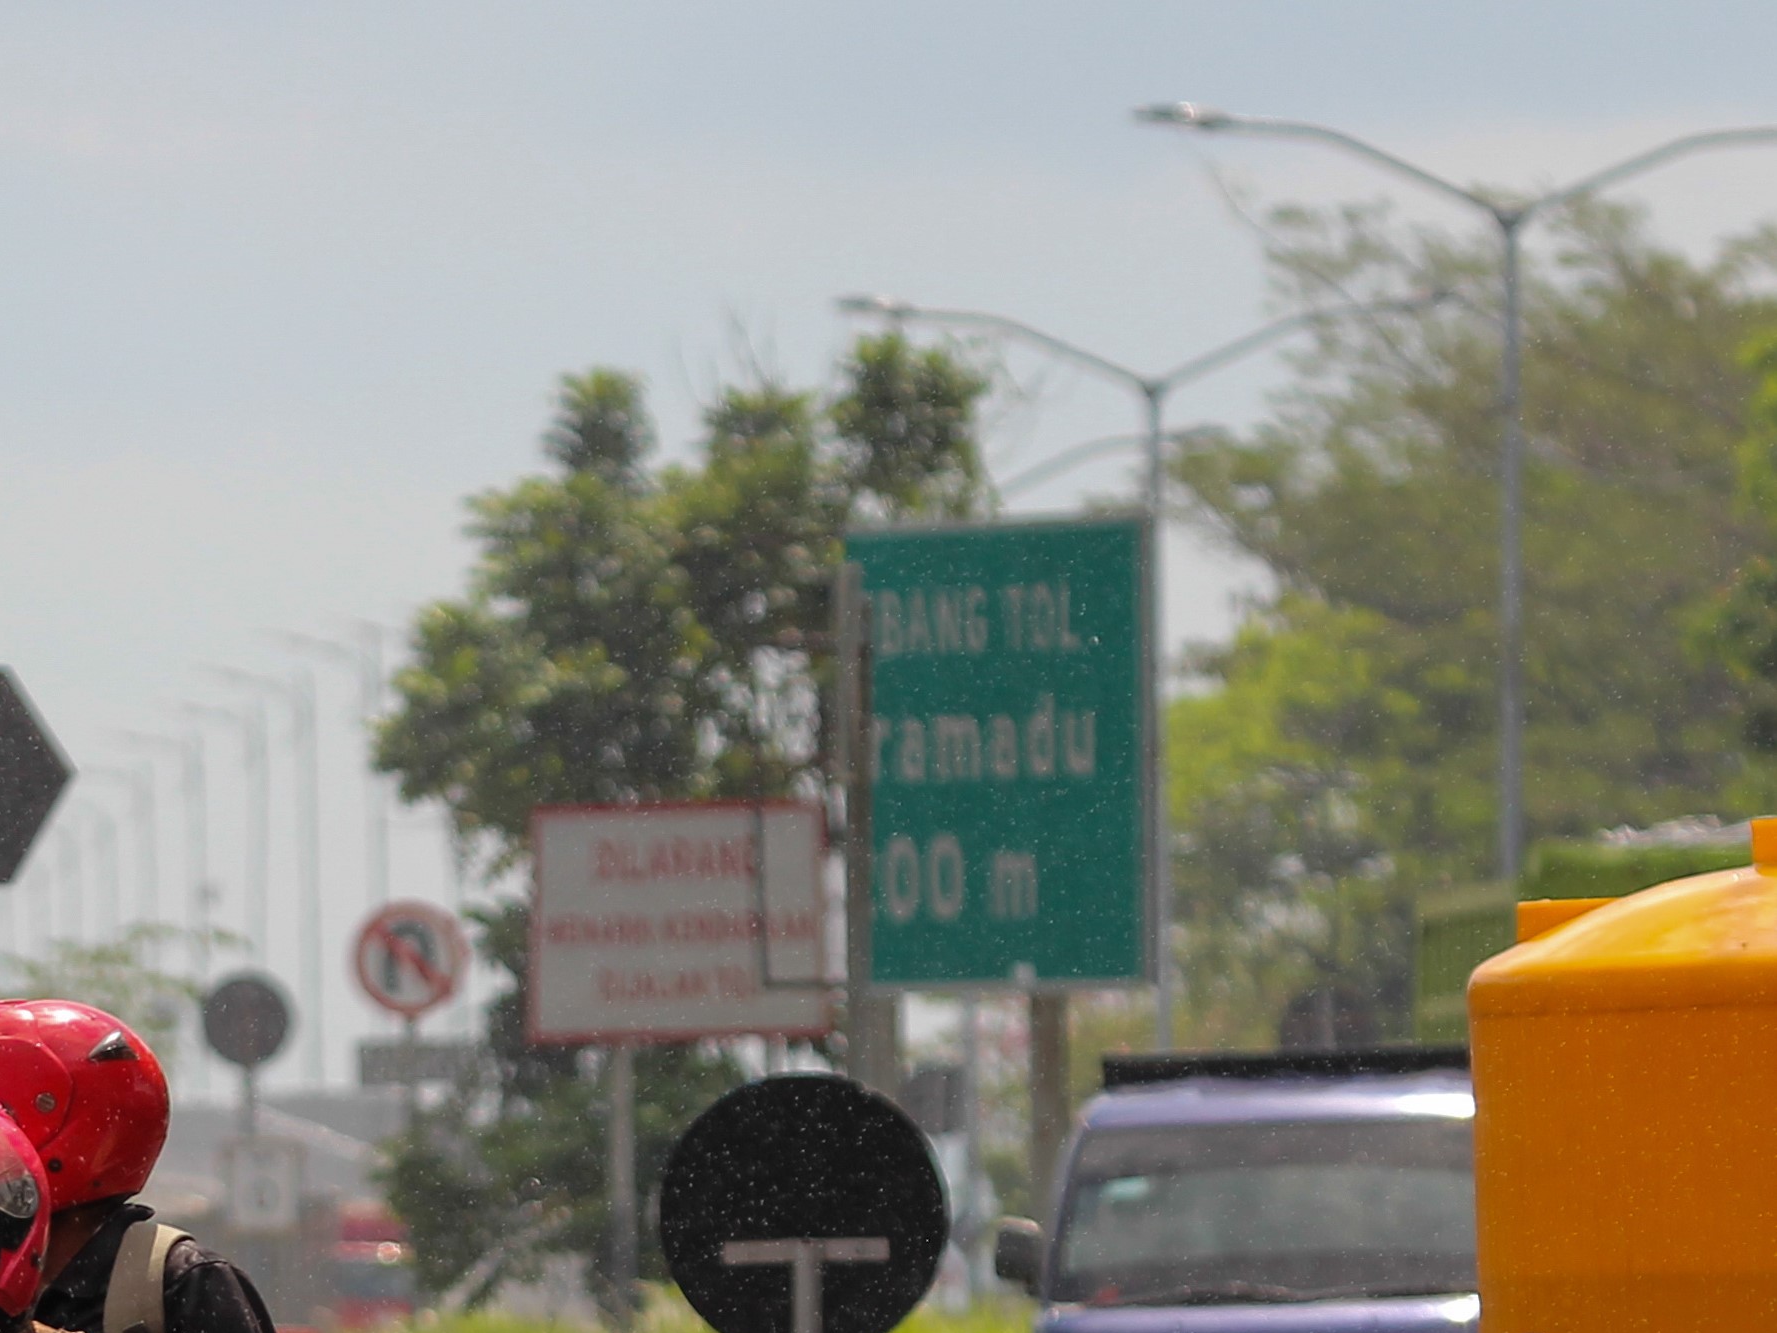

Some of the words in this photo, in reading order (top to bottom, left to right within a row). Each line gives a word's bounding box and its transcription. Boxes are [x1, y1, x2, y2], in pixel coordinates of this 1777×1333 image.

[860, 584, 989, 657] BANG
[1001, 580, 1083, 650] TOL
[870, 692, 1098, 786] ramadu
[882, 831, 966, 925] 00
[988, 848, 1039, 921] m
